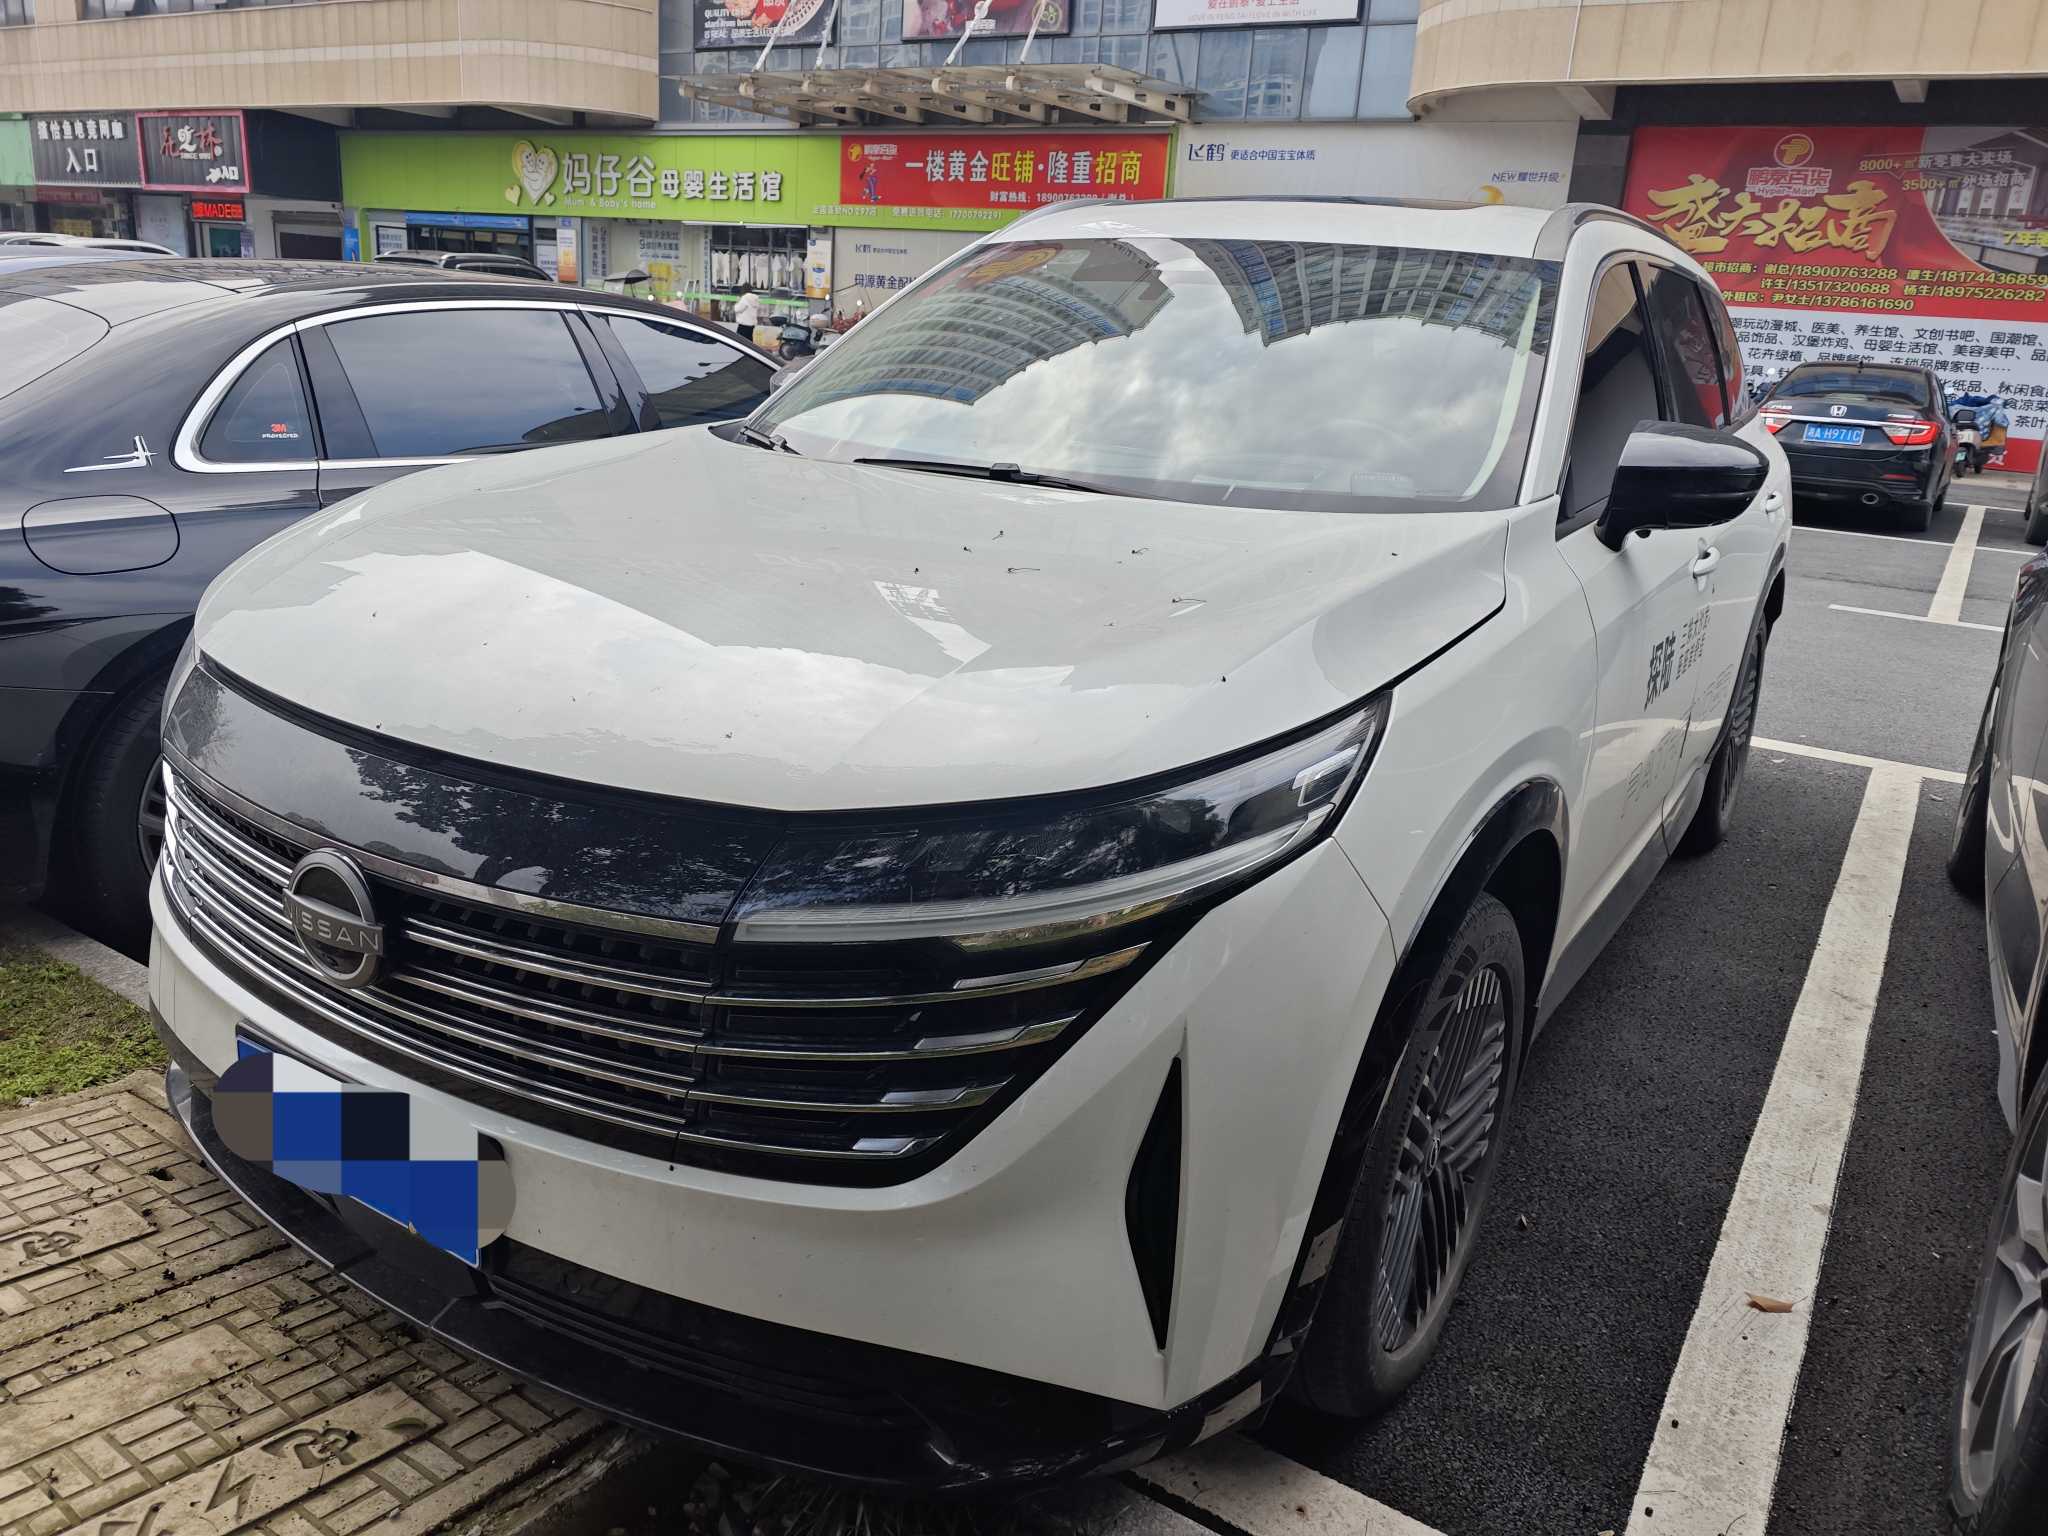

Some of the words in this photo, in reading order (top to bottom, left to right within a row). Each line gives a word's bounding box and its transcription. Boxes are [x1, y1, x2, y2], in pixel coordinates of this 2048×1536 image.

[66, 148, 98, 174] 入口
[905, 149, 1143, 186] 一楼黄金旺铺·隆重招商
[1188, 143, 1226, 162] 飞鹤
[1230, 149, 1317, 161] 更适合中国宝宝体质
[563, 153, 656, 198] 妈仔谷
[660, 169, 783, 202] 母婴生活馆
[1648, 173, 1897, 262] 盛大招商
[283, 895, 380, 951] NISSAN
